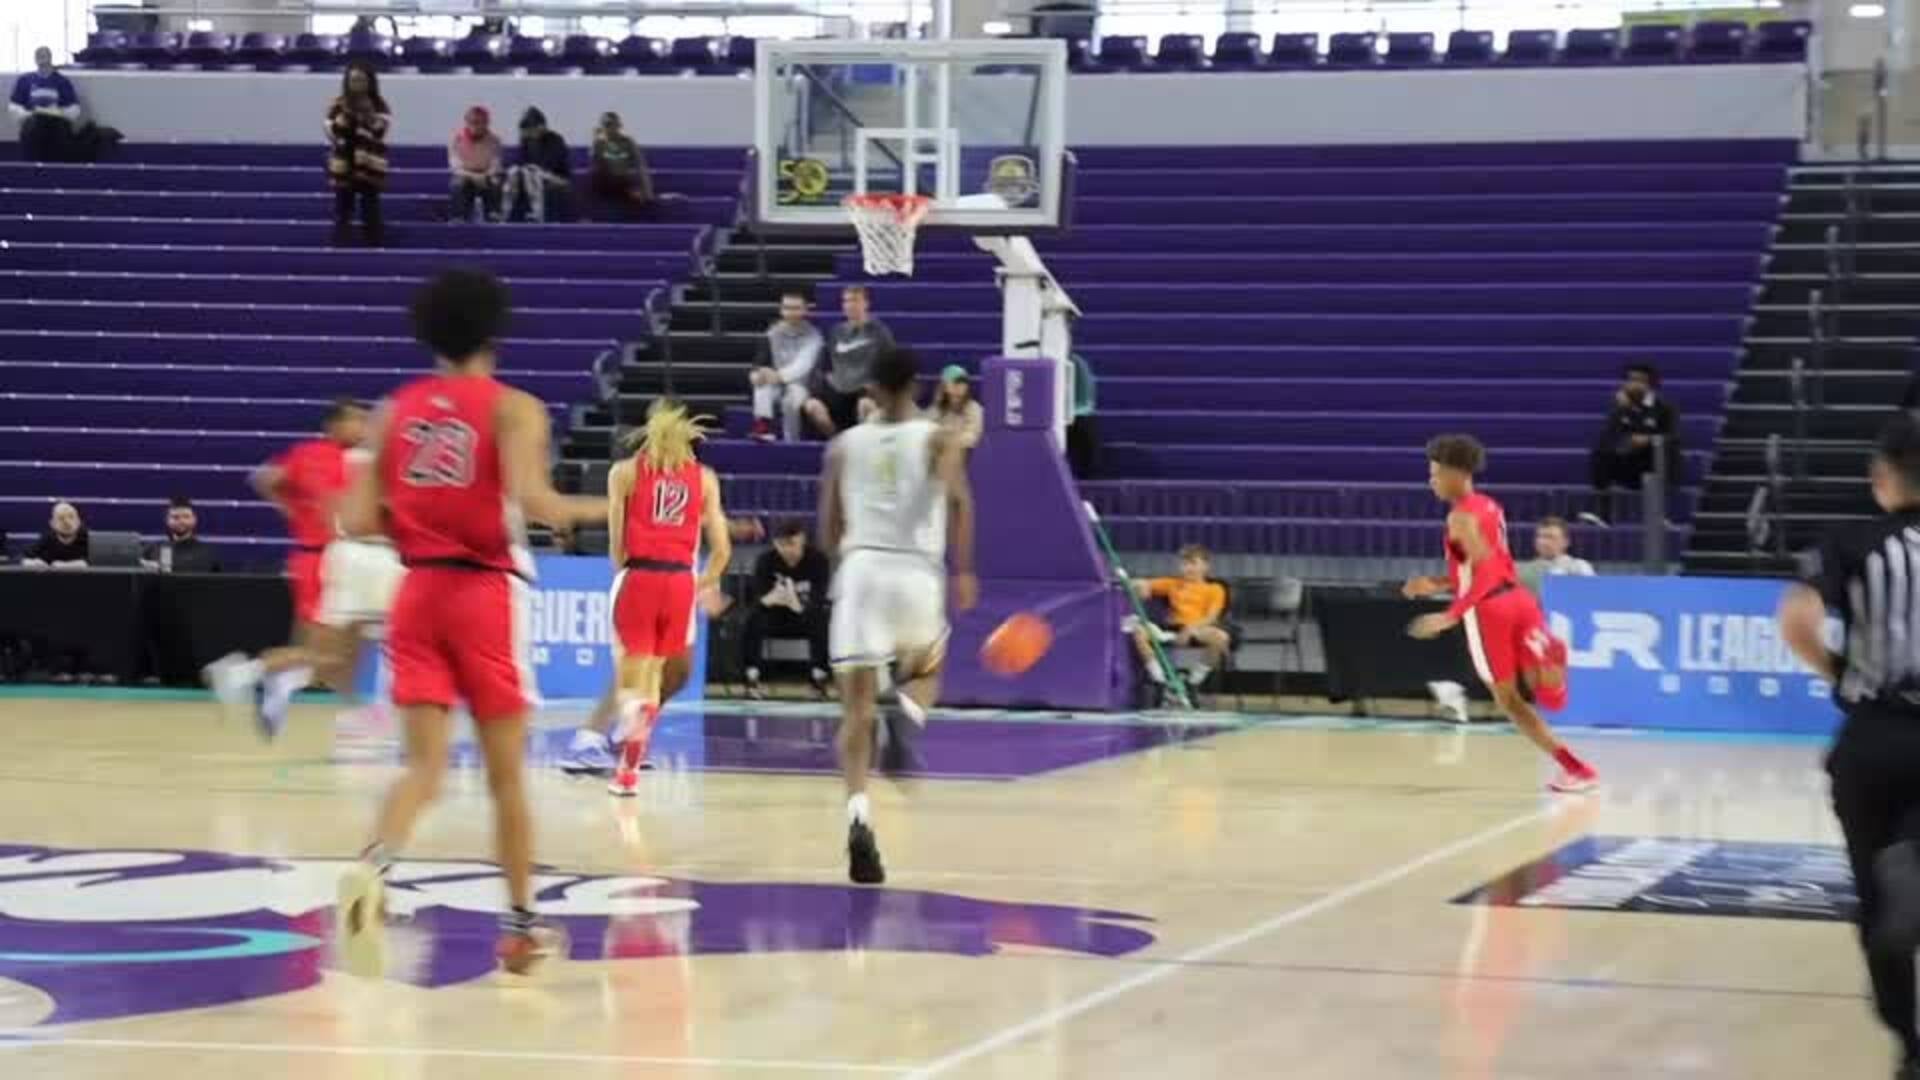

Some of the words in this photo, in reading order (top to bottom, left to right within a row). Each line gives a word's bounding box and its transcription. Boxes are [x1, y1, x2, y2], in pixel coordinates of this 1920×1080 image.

[401, 416, 479, 487] 23
[653, 480, 688, 526] 12
[529, 590, 609, 643] GUER
